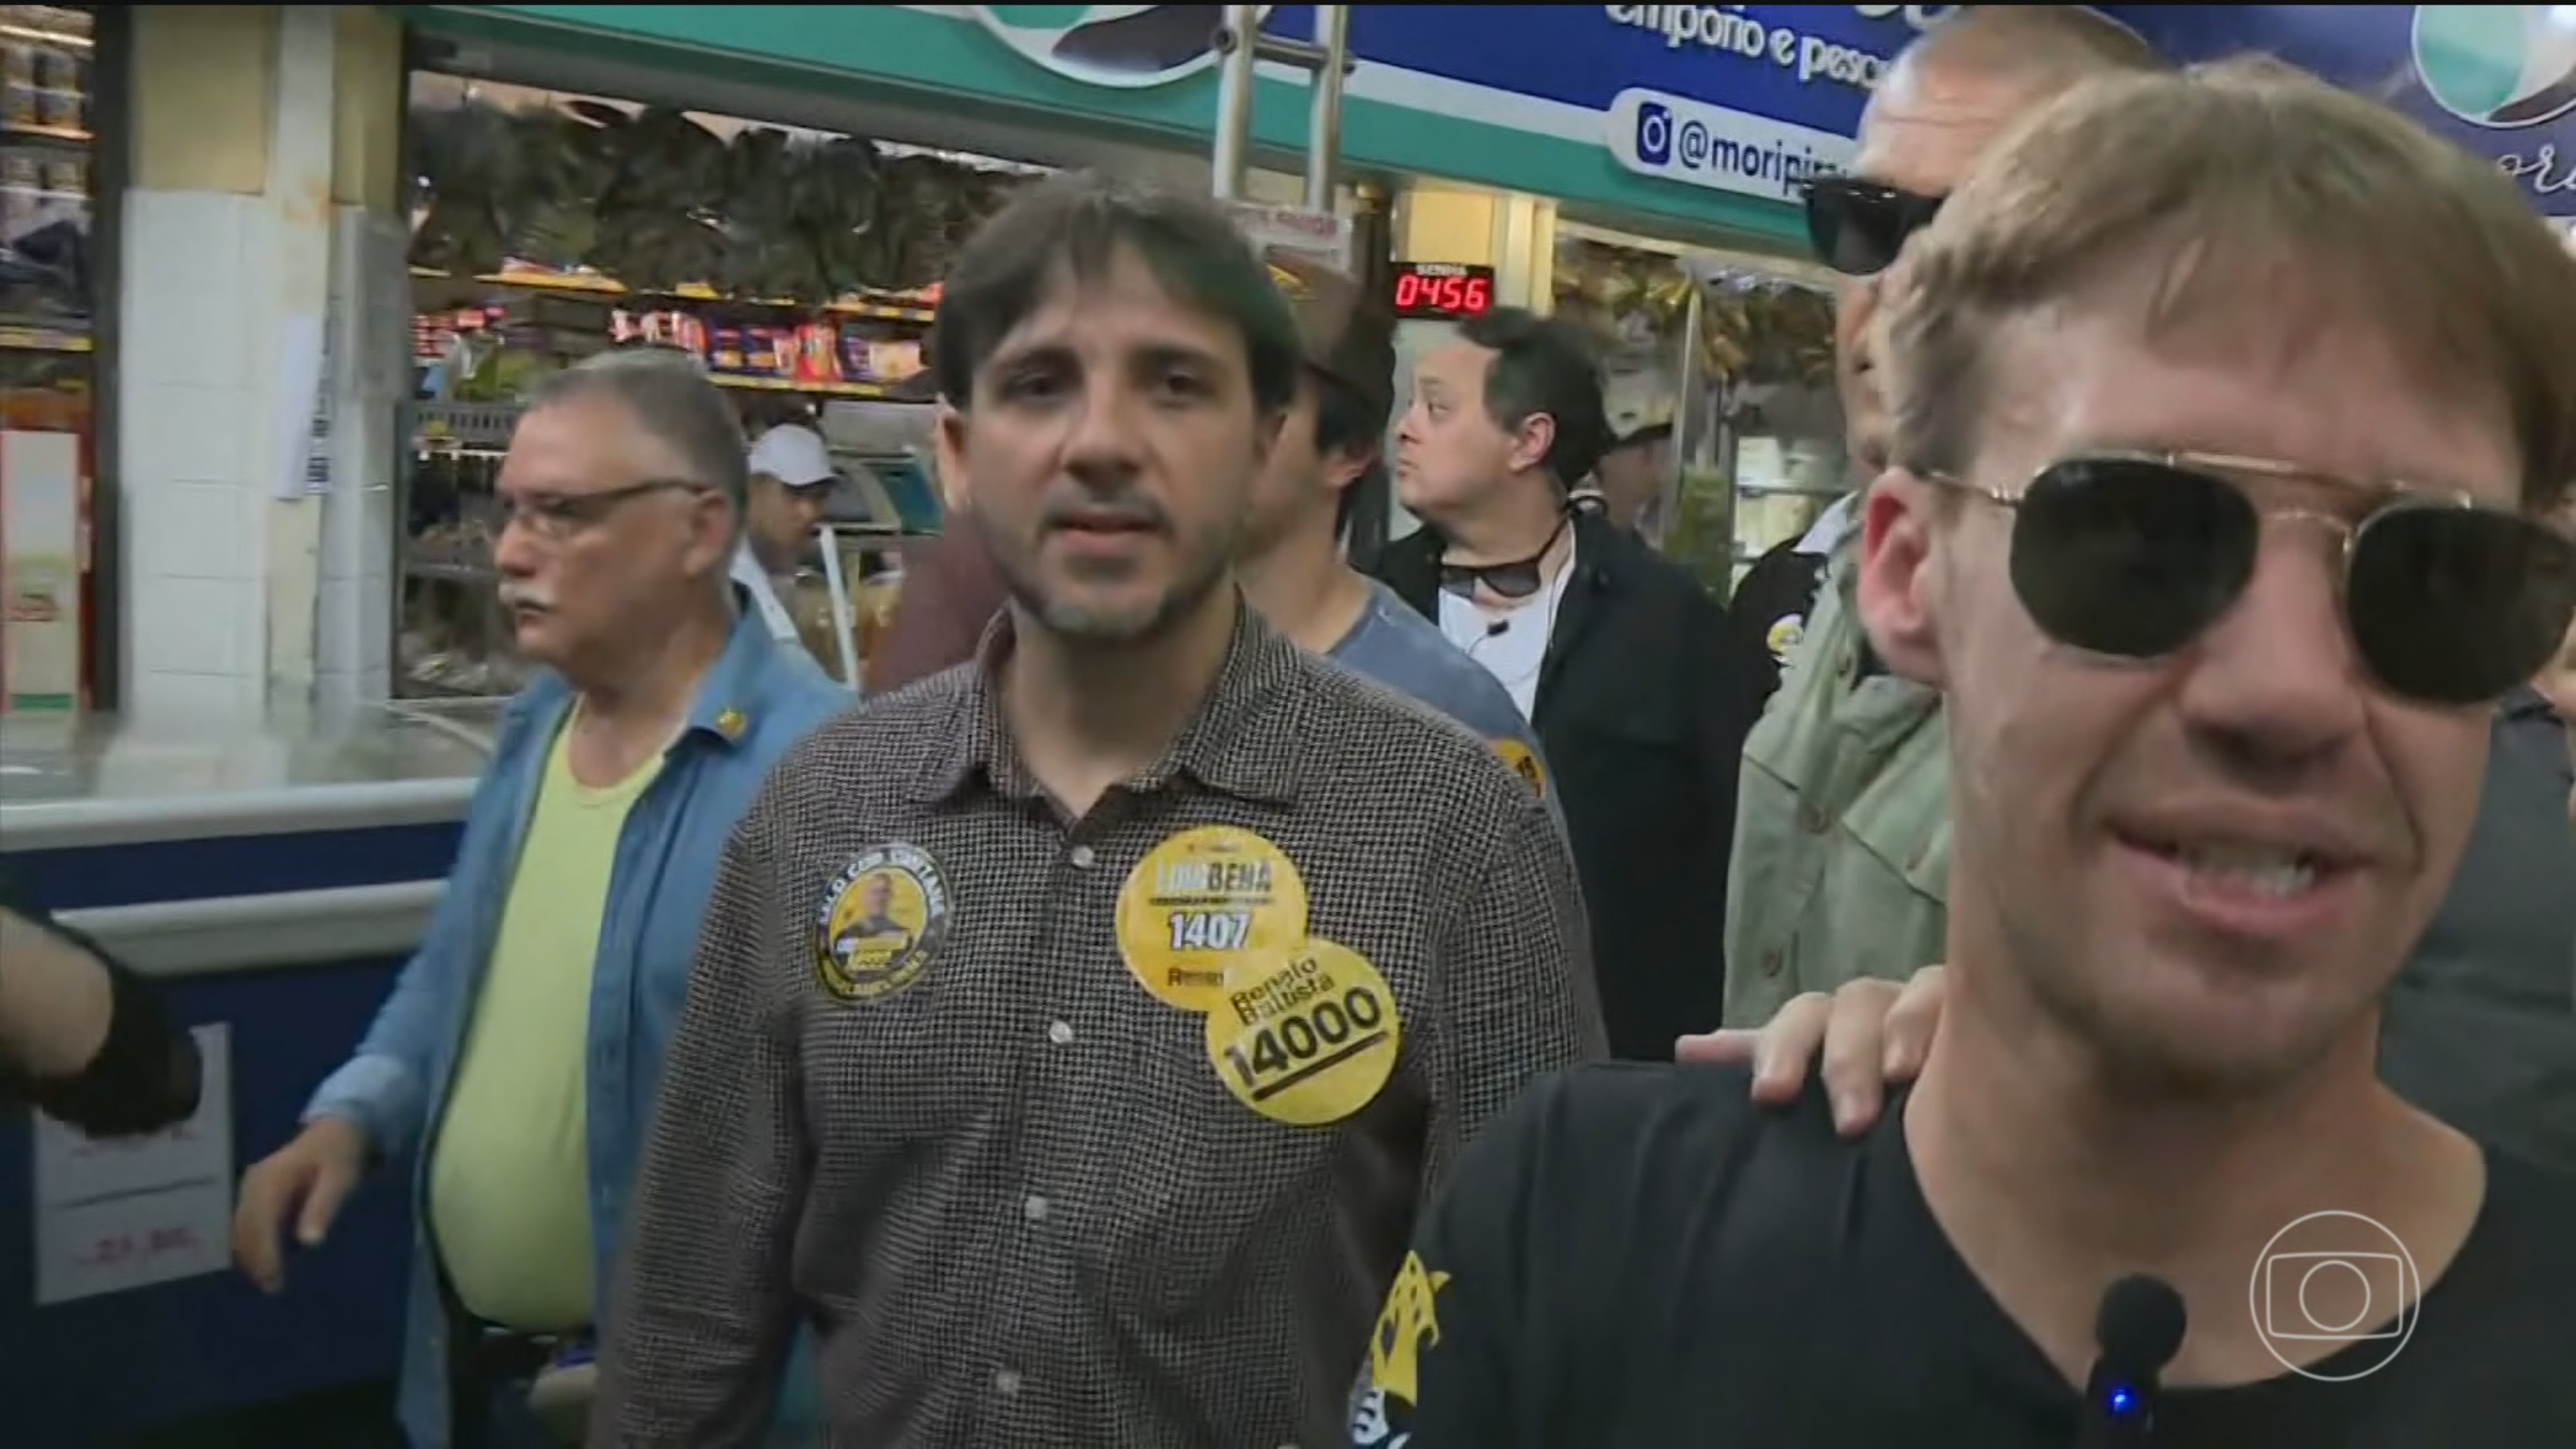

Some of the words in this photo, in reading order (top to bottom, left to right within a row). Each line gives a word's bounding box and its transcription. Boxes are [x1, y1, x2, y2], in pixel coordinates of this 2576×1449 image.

[1770, 29, 1795, 66] e
[1395, 275, 1488, 309] 0456
[1169, 912, 1252, 951] 1407
[1224, 986, 1381, 1088] 14000
